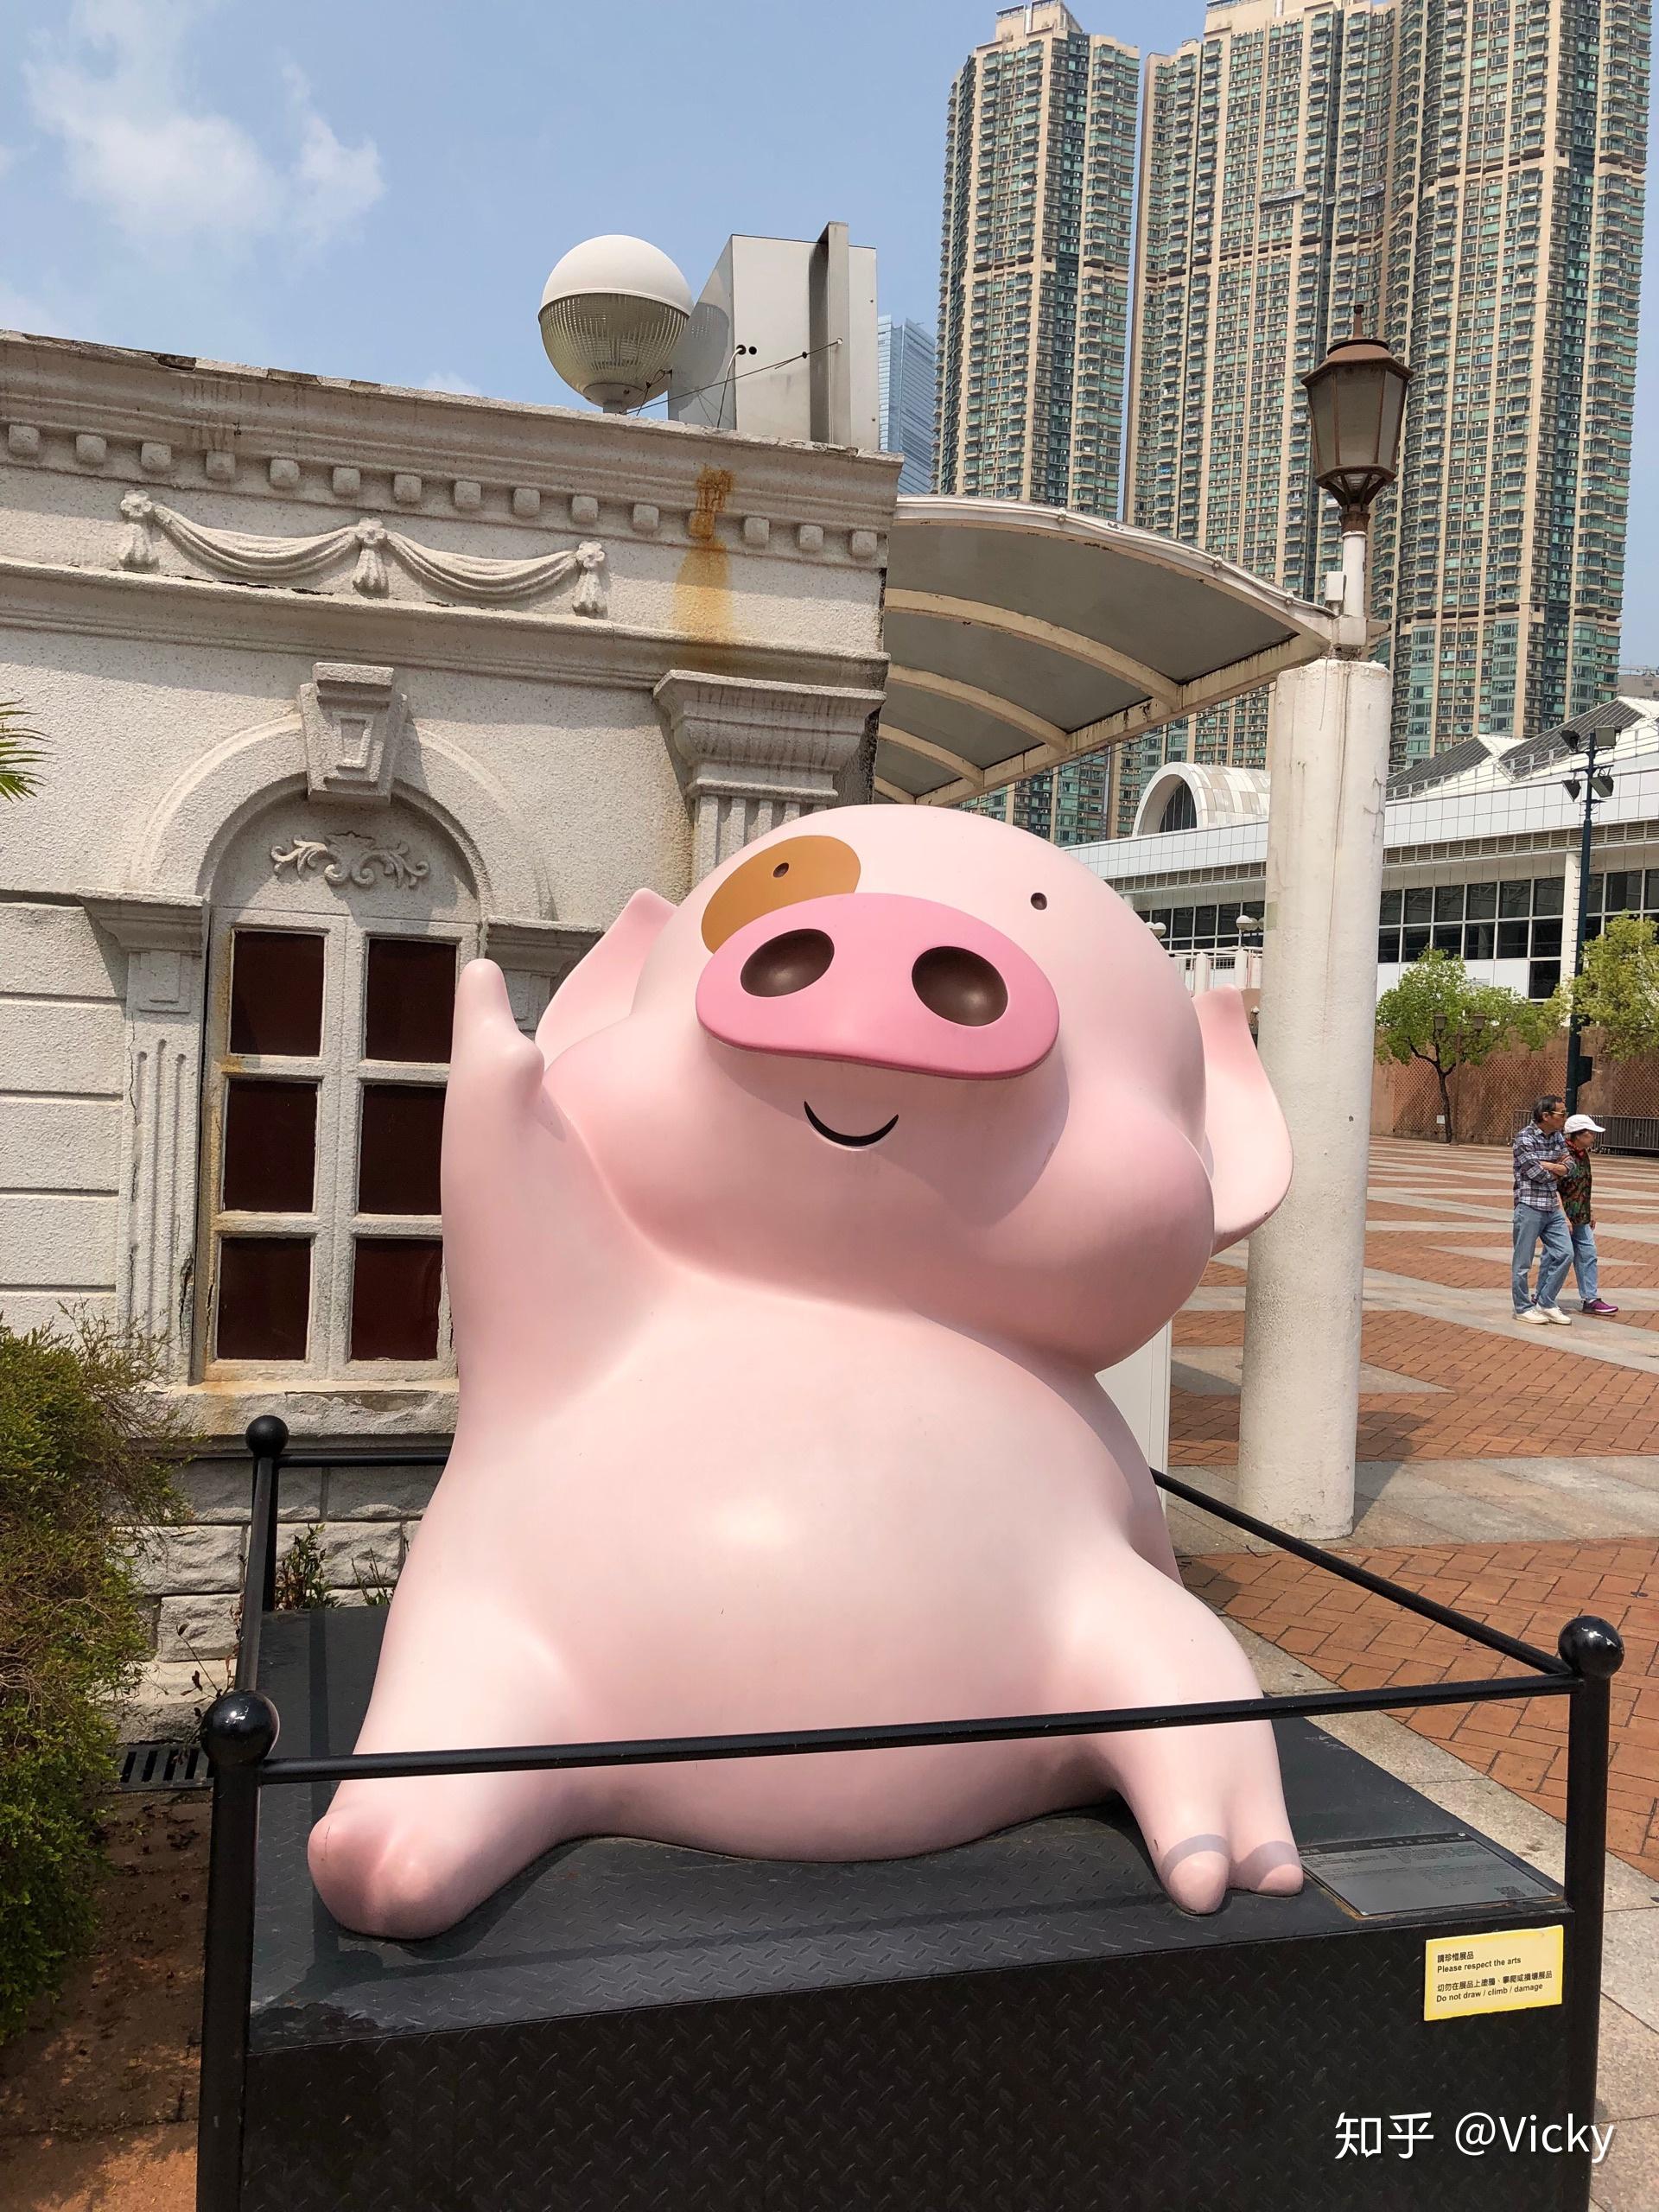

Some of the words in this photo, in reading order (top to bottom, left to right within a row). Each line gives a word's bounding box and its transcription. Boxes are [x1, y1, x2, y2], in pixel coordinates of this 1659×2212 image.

[1437, 1951, 1474, 1963] 請珍惜展品
[1465, 1961, 1491, 1971] respect
[1436, 1994, 1447, 2003] Do
[1449, 1992, 1461, 2000] not
[1463, 1989, 1481, 1999] draw
[1488, 1986, 1508, 1996] climb
[1514, 1983, 1542, 1993] damage
